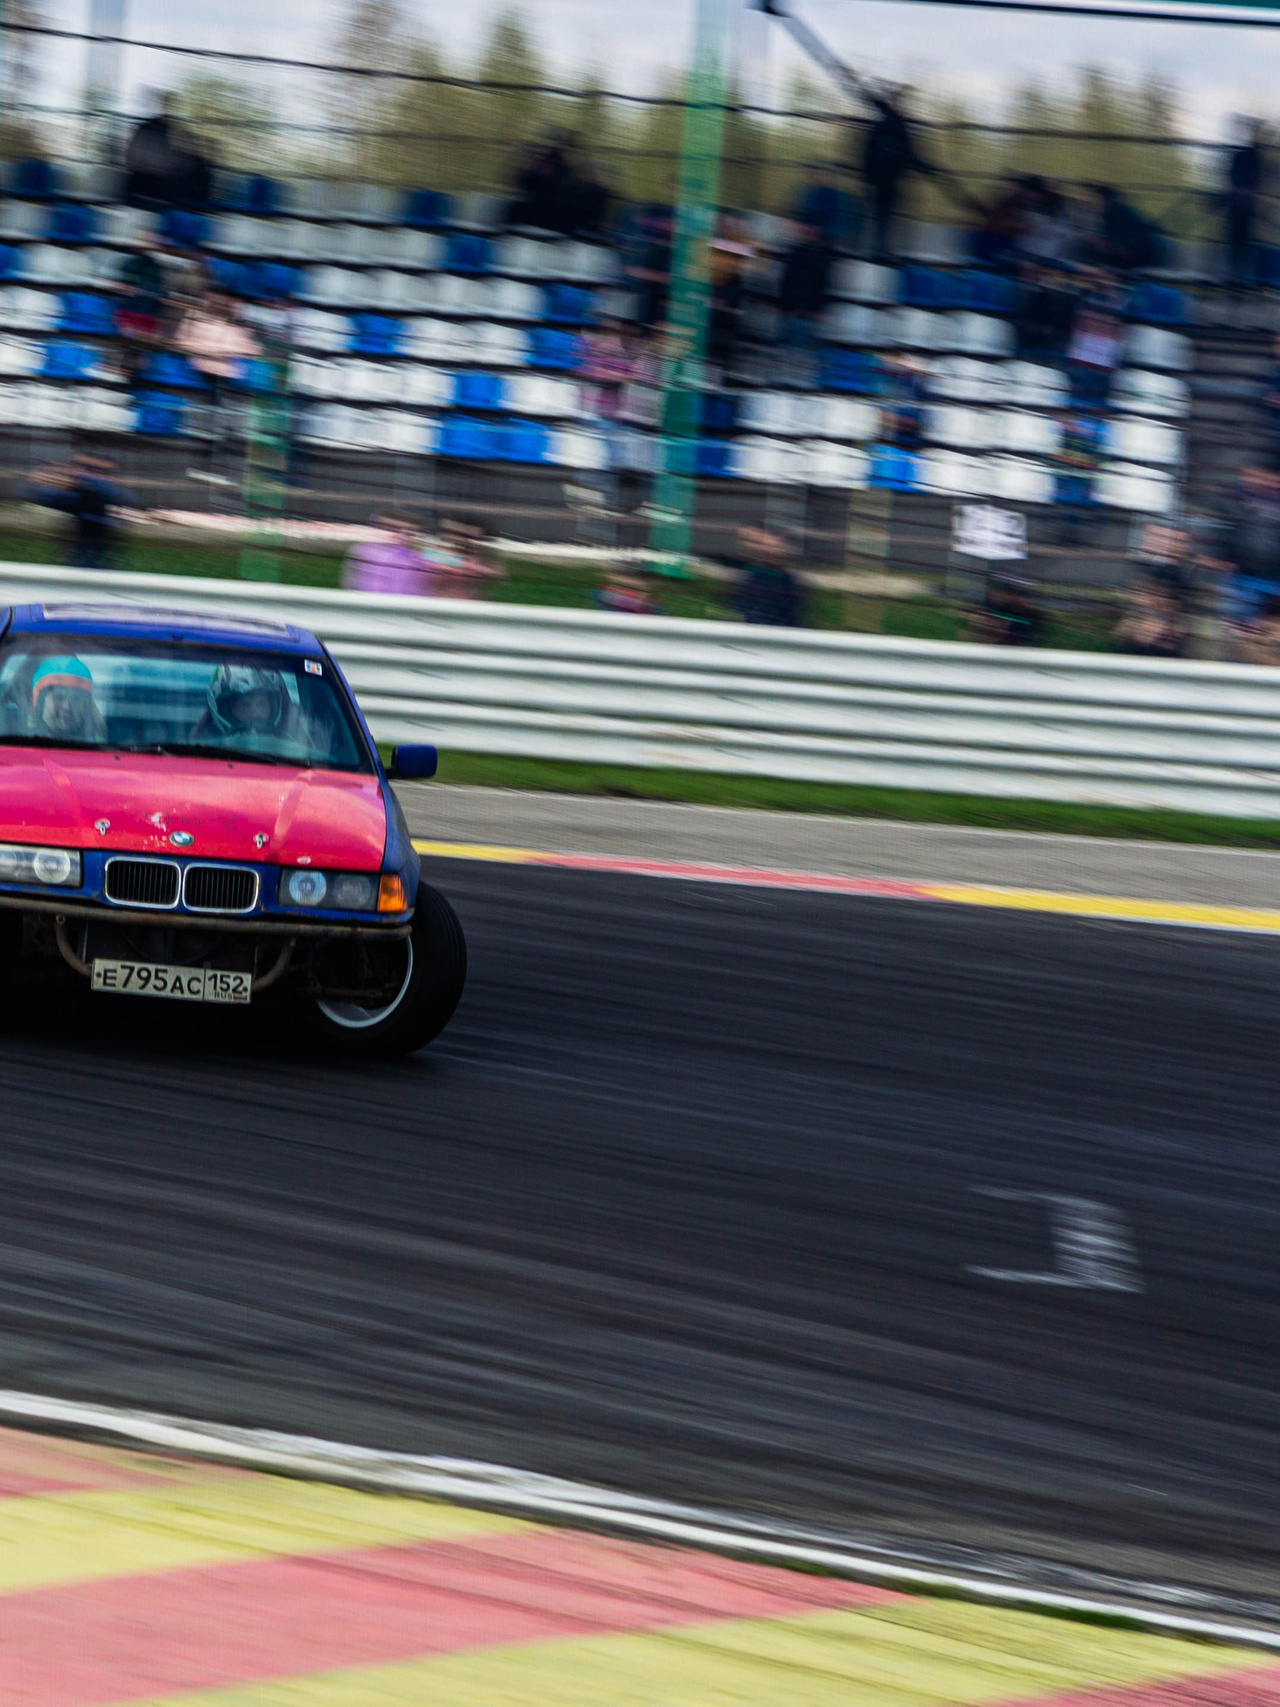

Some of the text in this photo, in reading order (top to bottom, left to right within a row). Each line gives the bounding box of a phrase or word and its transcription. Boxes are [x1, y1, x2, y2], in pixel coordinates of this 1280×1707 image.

[102, 964, 244, 996] E795AC 152
[214, 992, 233, 1001] RUS
